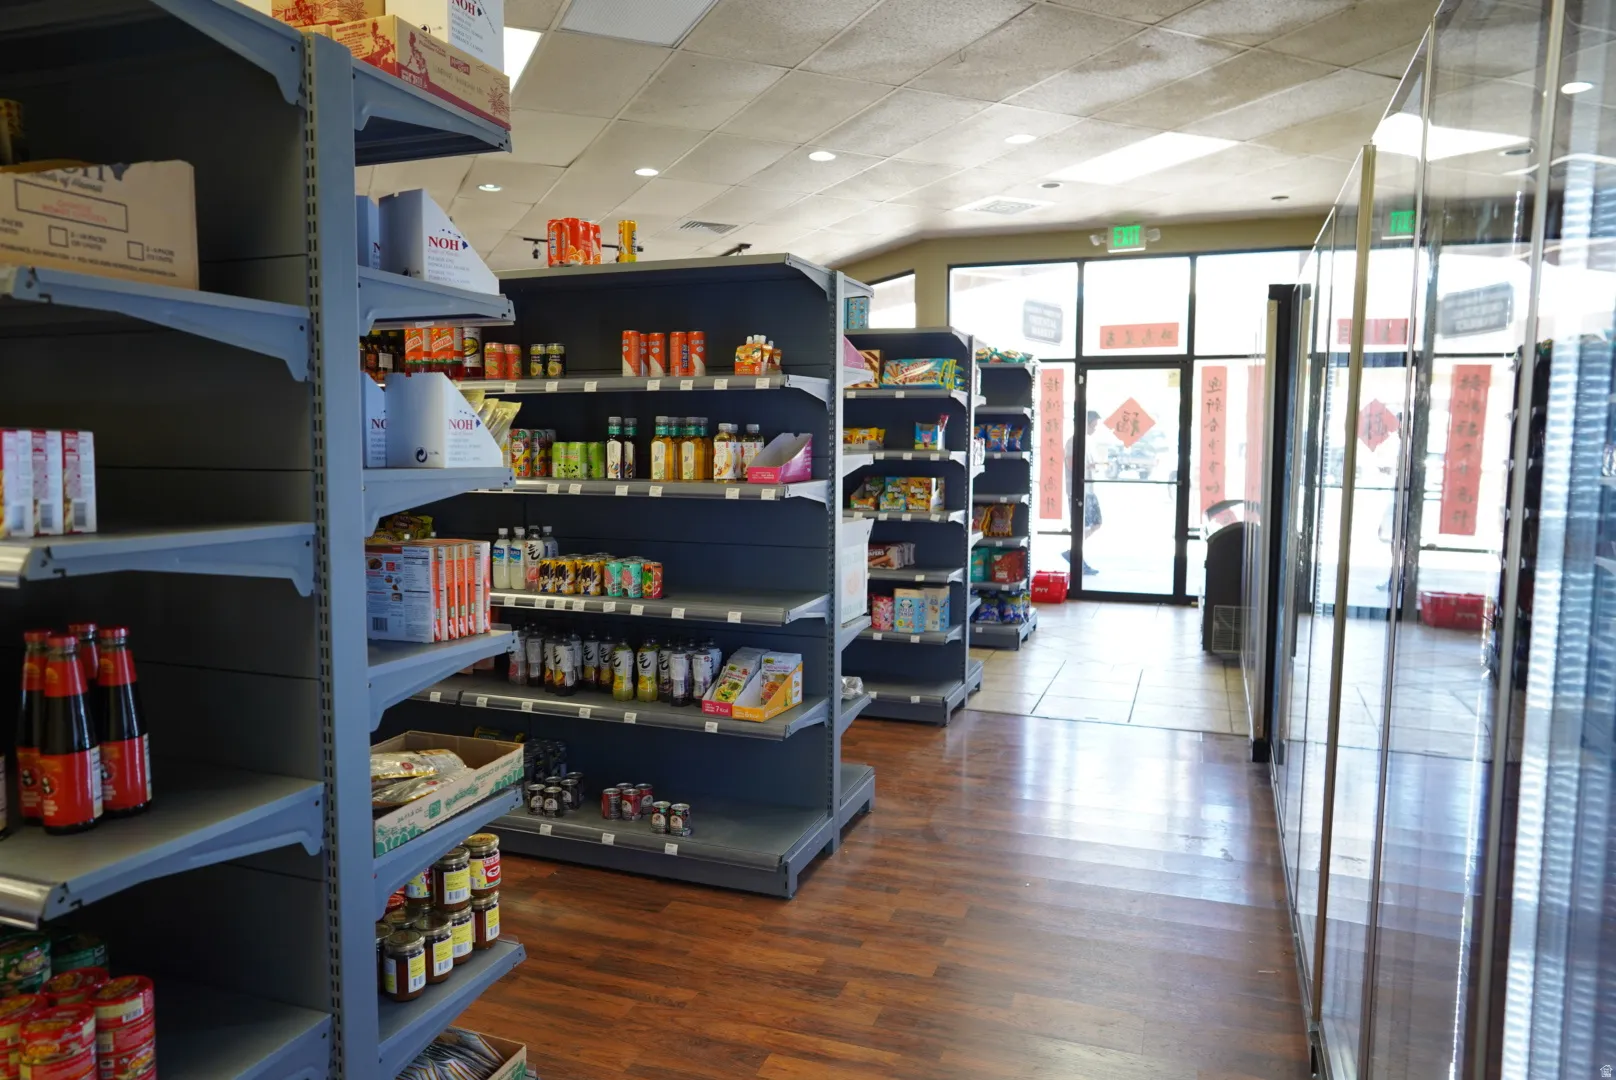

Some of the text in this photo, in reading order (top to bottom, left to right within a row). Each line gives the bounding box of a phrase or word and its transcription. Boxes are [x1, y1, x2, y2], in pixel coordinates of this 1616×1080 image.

[427, 235, 459, 251] NOH
[1113, 225, 1141, 247] EXIT
[371, 418, 388, 430] NO
[448, 418, 473, 431] NOH
